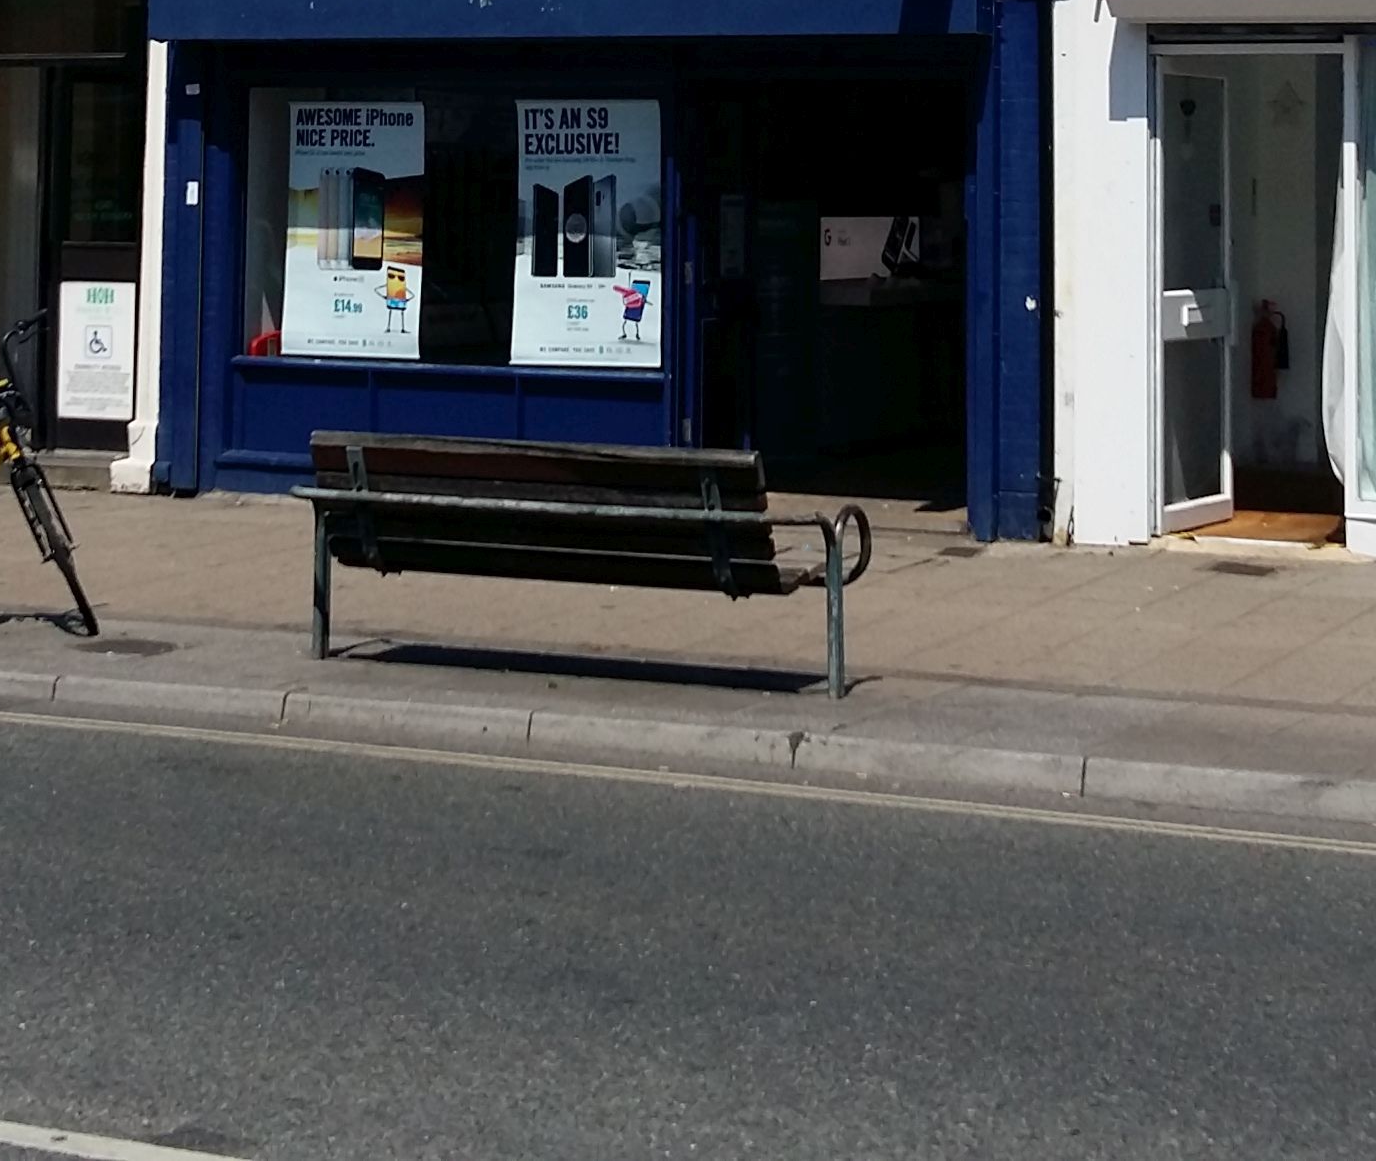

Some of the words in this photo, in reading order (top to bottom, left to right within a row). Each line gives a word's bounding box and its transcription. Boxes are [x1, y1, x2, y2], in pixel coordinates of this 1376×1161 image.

[295, 108, 362, 127] AWESOME
[365, 108, 414, 127] iPhone
[524, 108, 555, 130] IT'S
[559, 107, 582, 130] AN
[586, 106, 609, 130] S9
[295, 128, 326, 147] NICE
[330, 128, 375, 148] PRICE.
[524, 132, 620, 155] EXCLUSIVE!
[566, 304, 589, 320] £36
